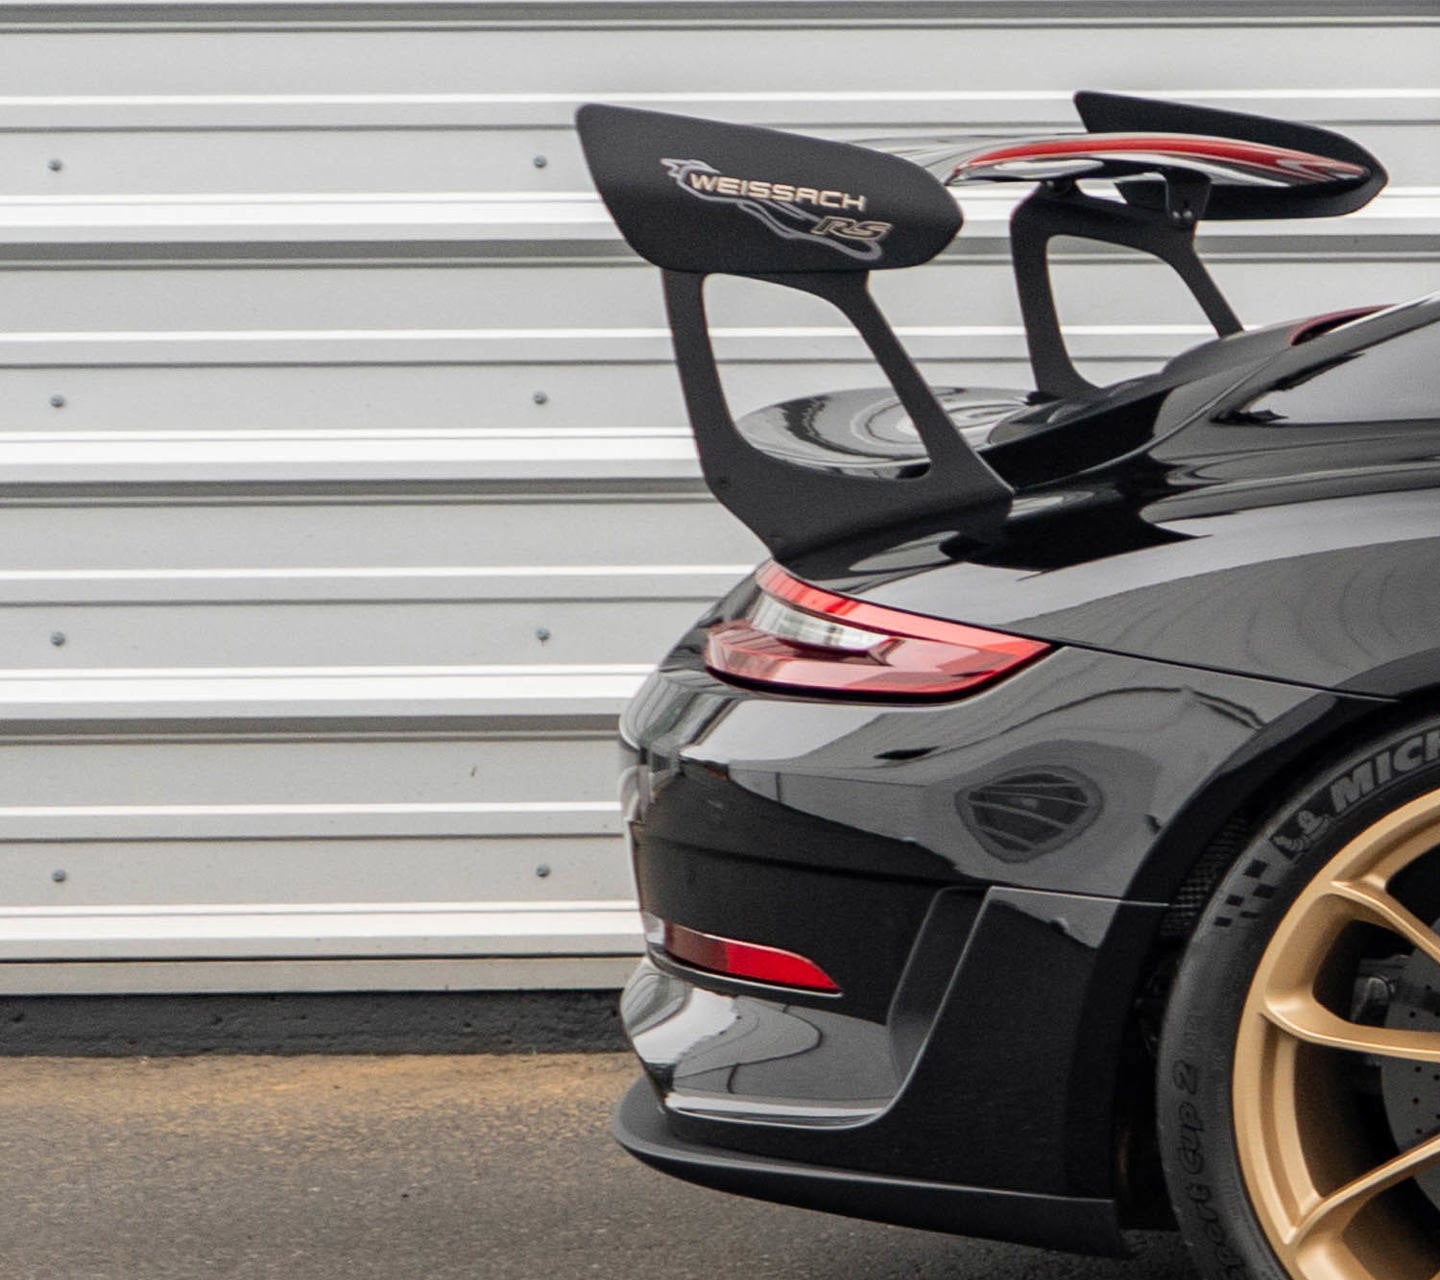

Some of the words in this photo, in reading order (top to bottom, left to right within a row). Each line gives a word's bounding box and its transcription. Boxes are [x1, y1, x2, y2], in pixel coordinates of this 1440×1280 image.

[689, 172, 867, 212] WEISSACH
[811, 215, 894, 242] RS
[1173, 1062, 1197, 1094] 2
[1177, 1101, 1206, 1172] Cup
